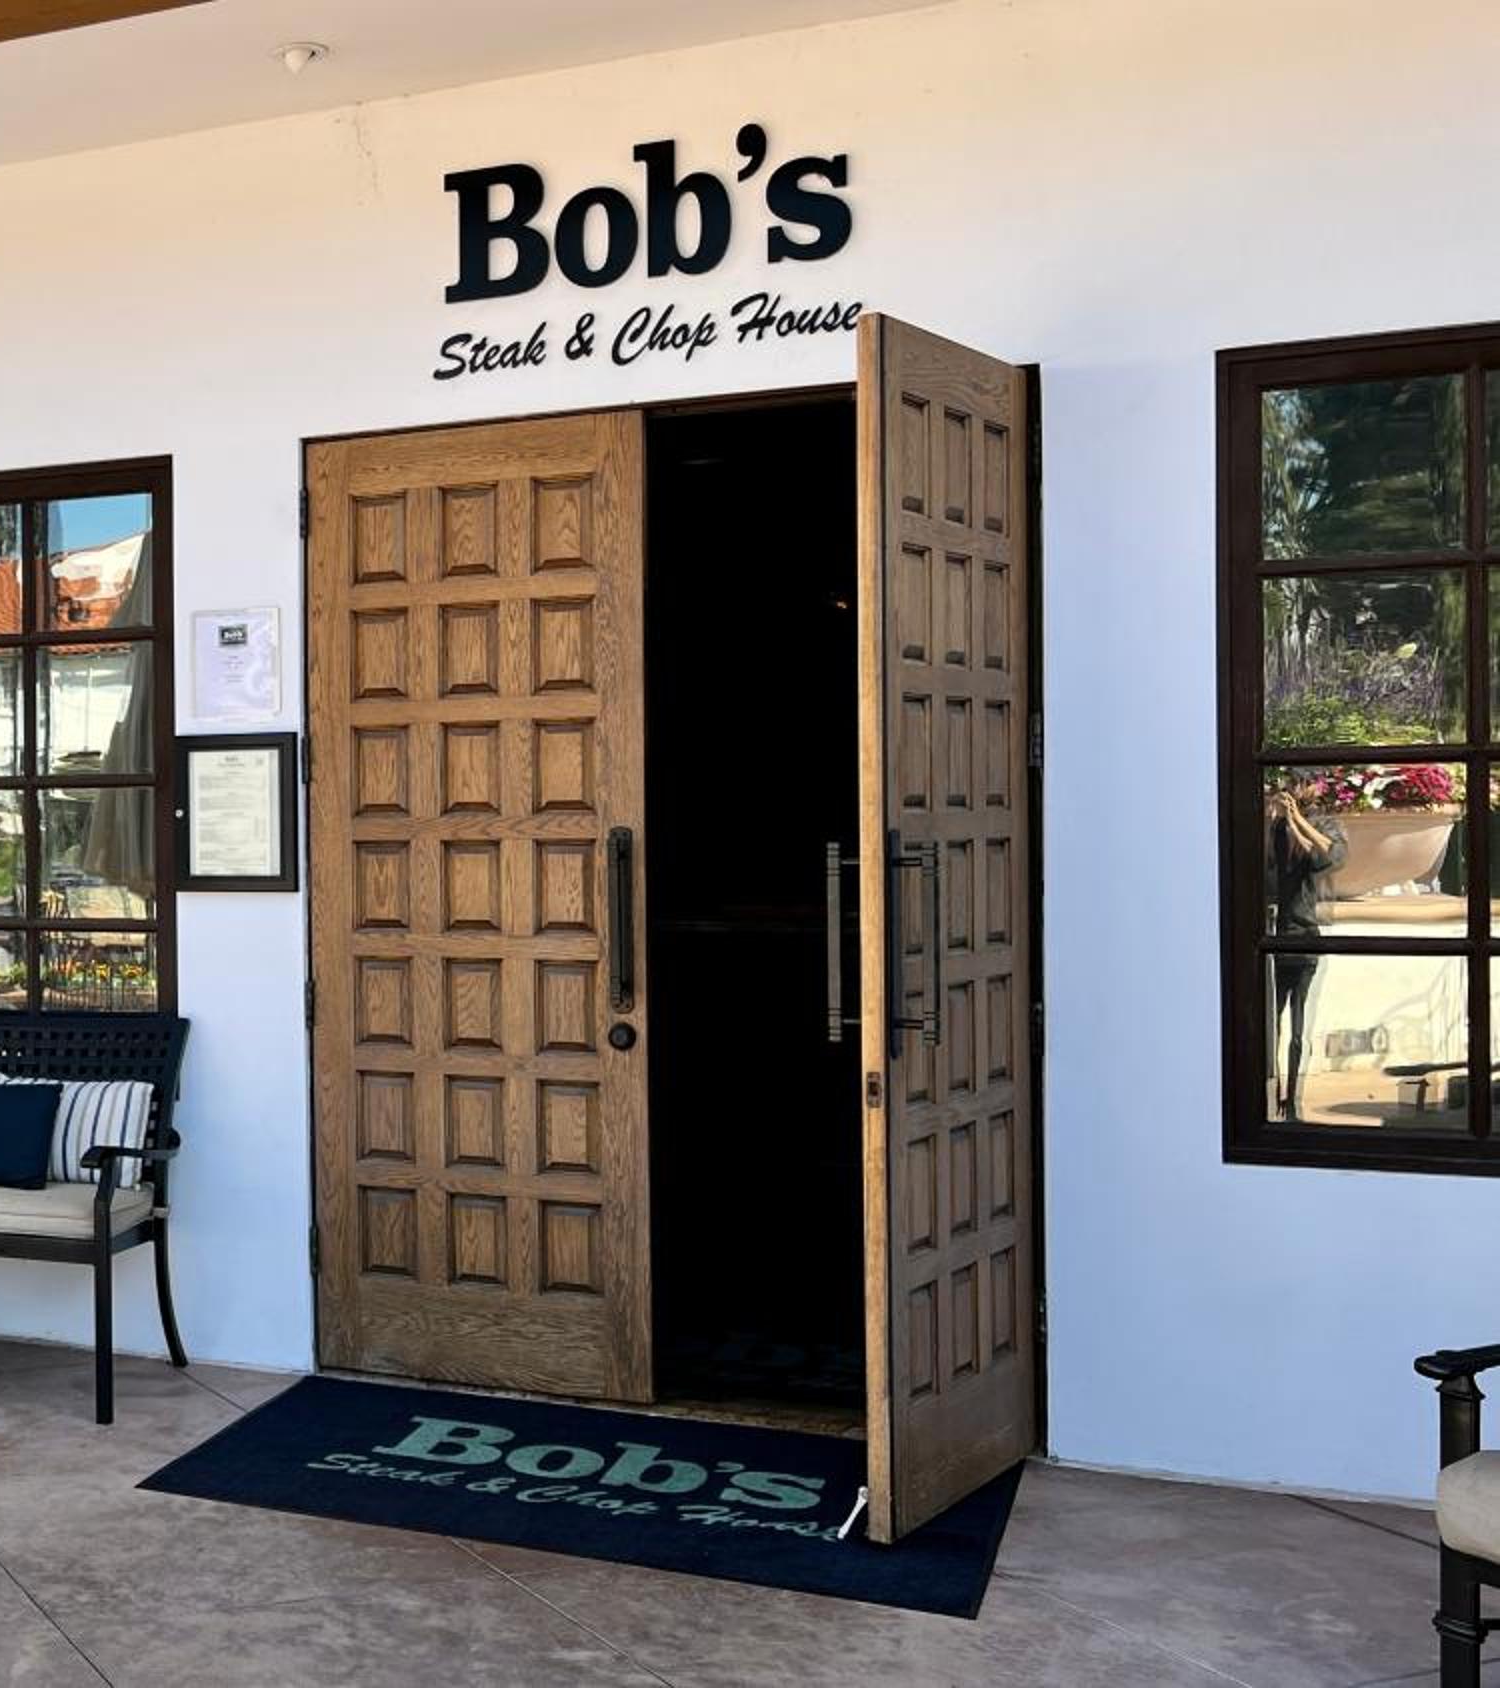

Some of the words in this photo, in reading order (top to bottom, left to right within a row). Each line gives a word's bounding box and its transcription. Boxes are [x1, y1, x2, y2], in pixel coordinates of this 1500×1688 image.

[444, 123, 853, 304] Bob's
[432, 321, 547, 381] Steak
[563, 312, 595, 361] &
[610, 304, 718, 366] Chop
[730, 291, 864, 344] House
[307, 1453, 465, 1486] Steak
[465, 1477, 516, 1494] &
[515, 1485, 660, 1516] Chop
[372, 1416, 826, 1509] Bob's
